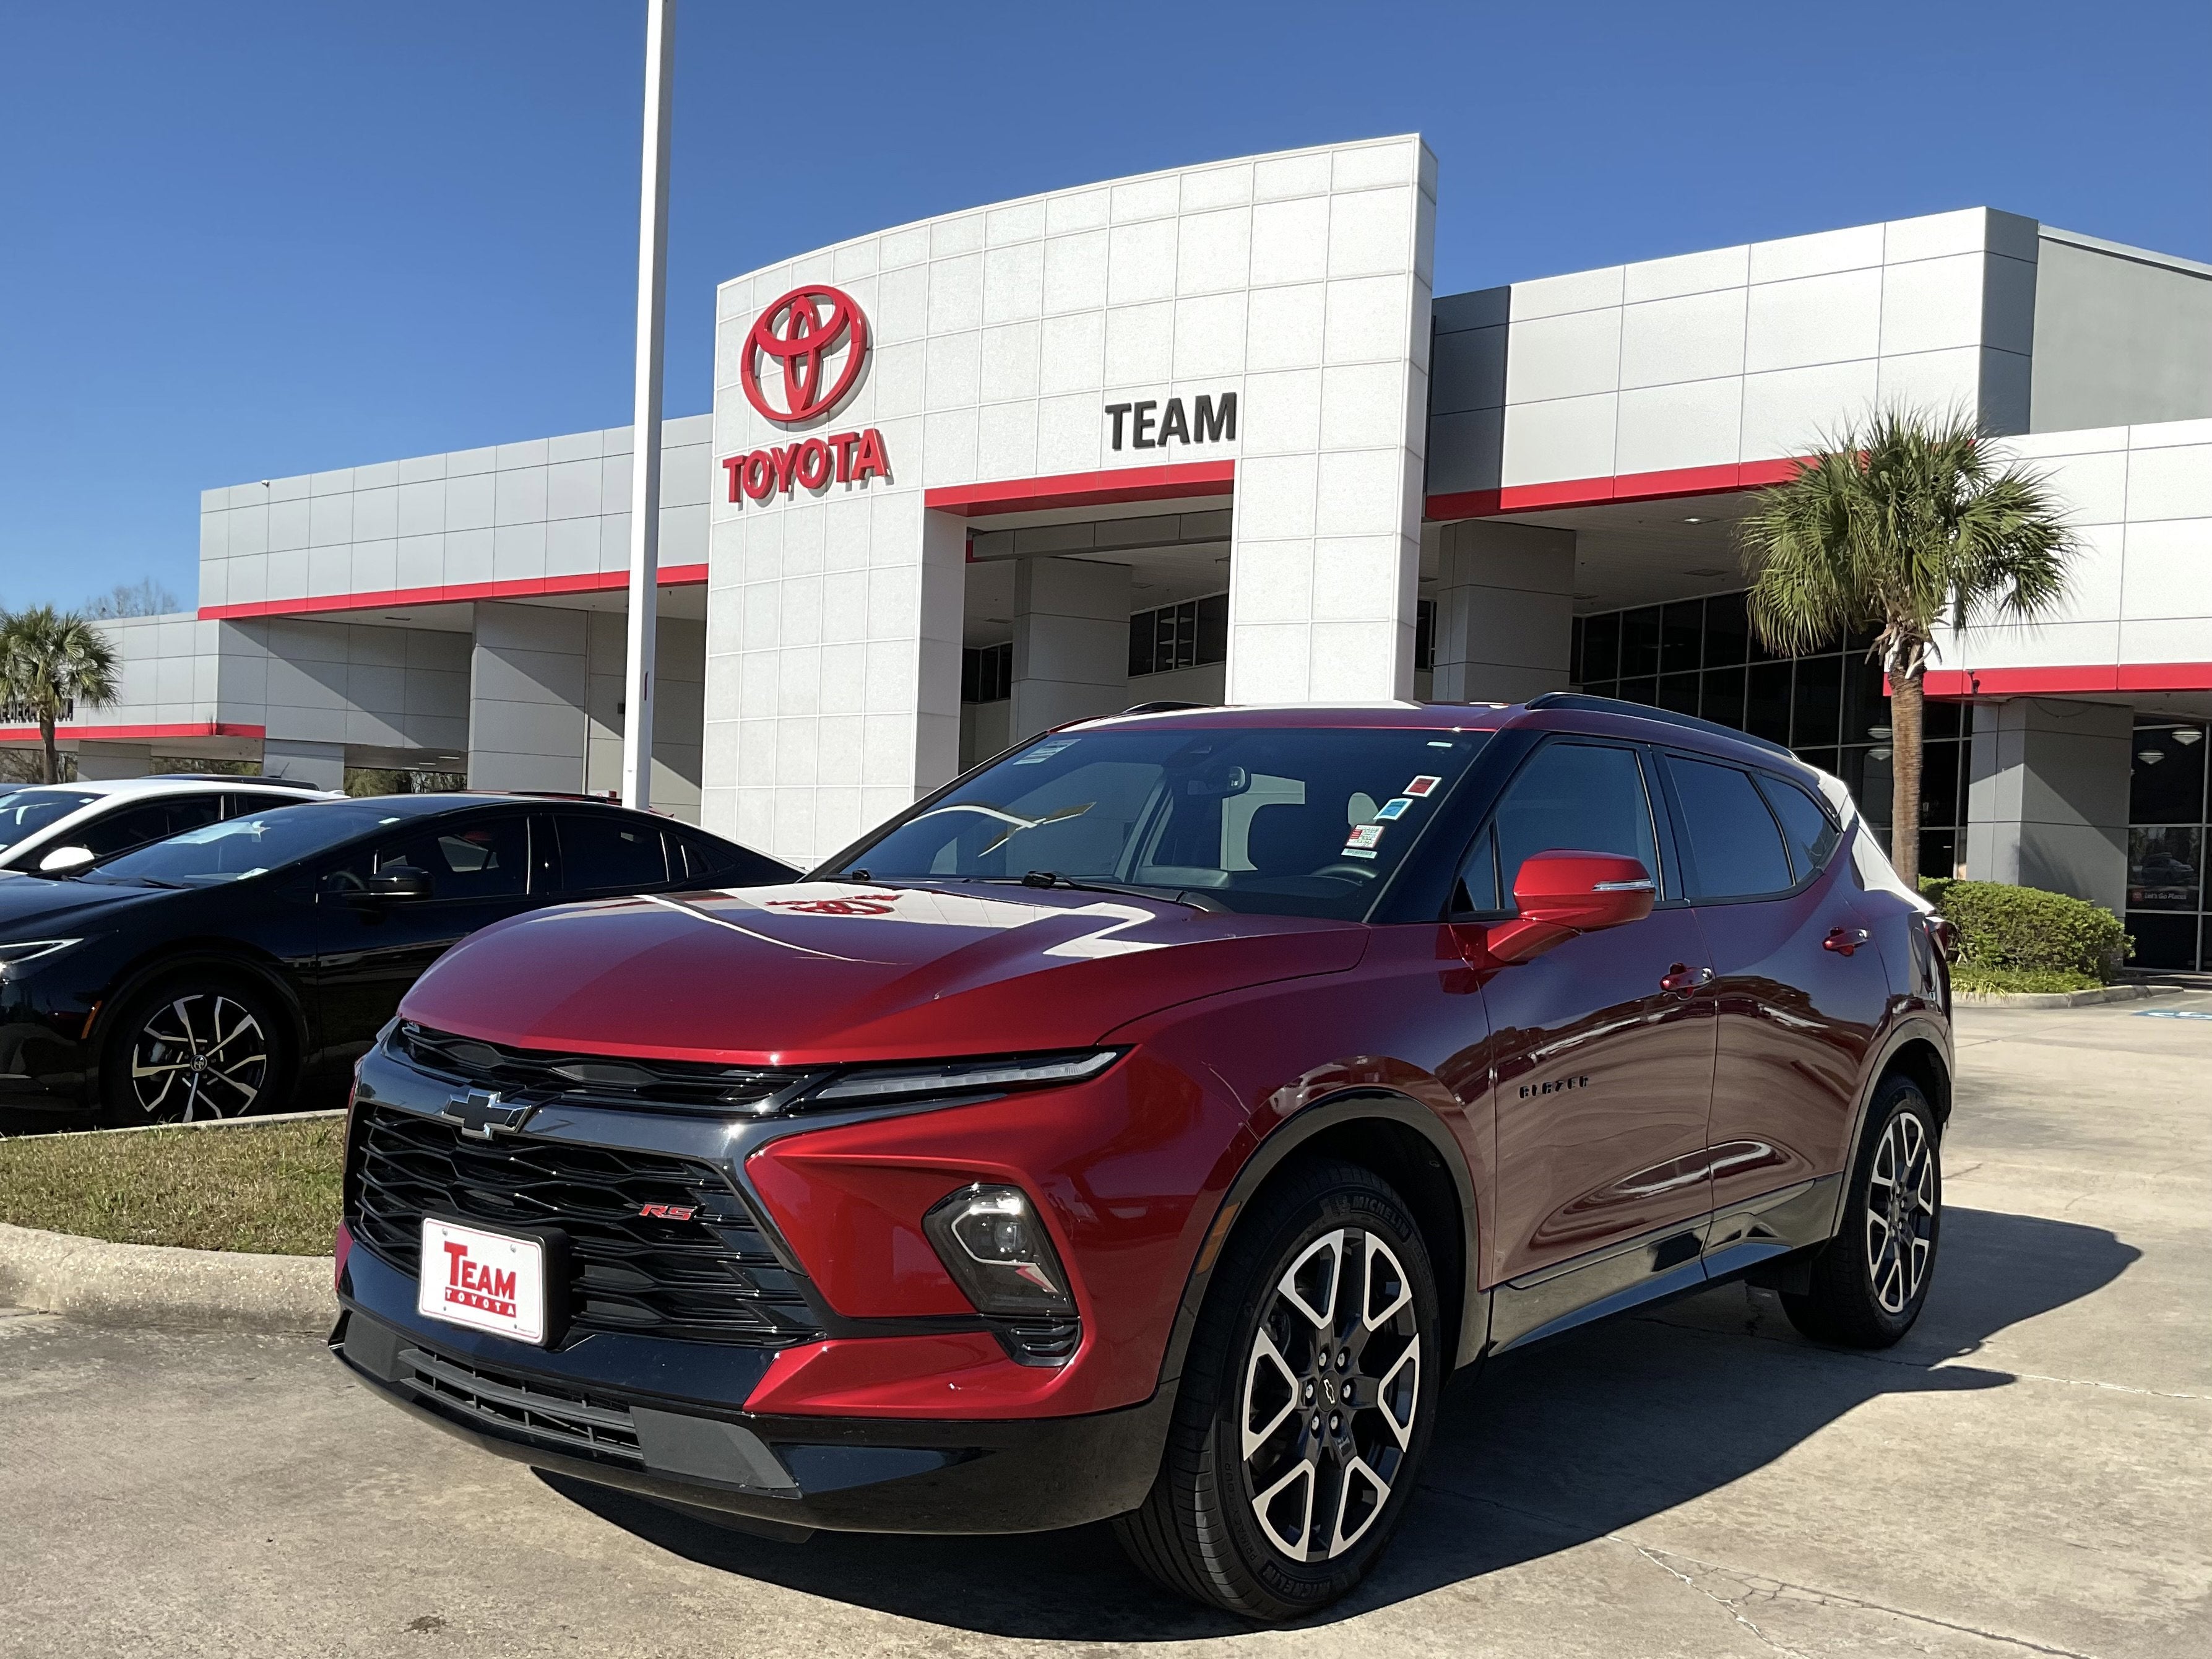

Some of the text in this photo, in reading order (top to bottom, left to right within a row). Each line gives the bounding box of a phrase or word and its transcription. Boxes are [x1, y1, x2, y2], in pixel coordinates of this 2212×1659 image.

[1105, 392, 1237, 450] TEAM
[723, 428, 889, 503] TOYOTA
[639, 1203, 696, 1221] RS
[1352, 1195, 1409, 1237] MICHELIN
[446, 1289, 516, 1315] TOYOTA
[1225, 1463, 1257, 1562] PRIMACY TOUR
[1263, 1564, 1331, 1597] MICHELIN
